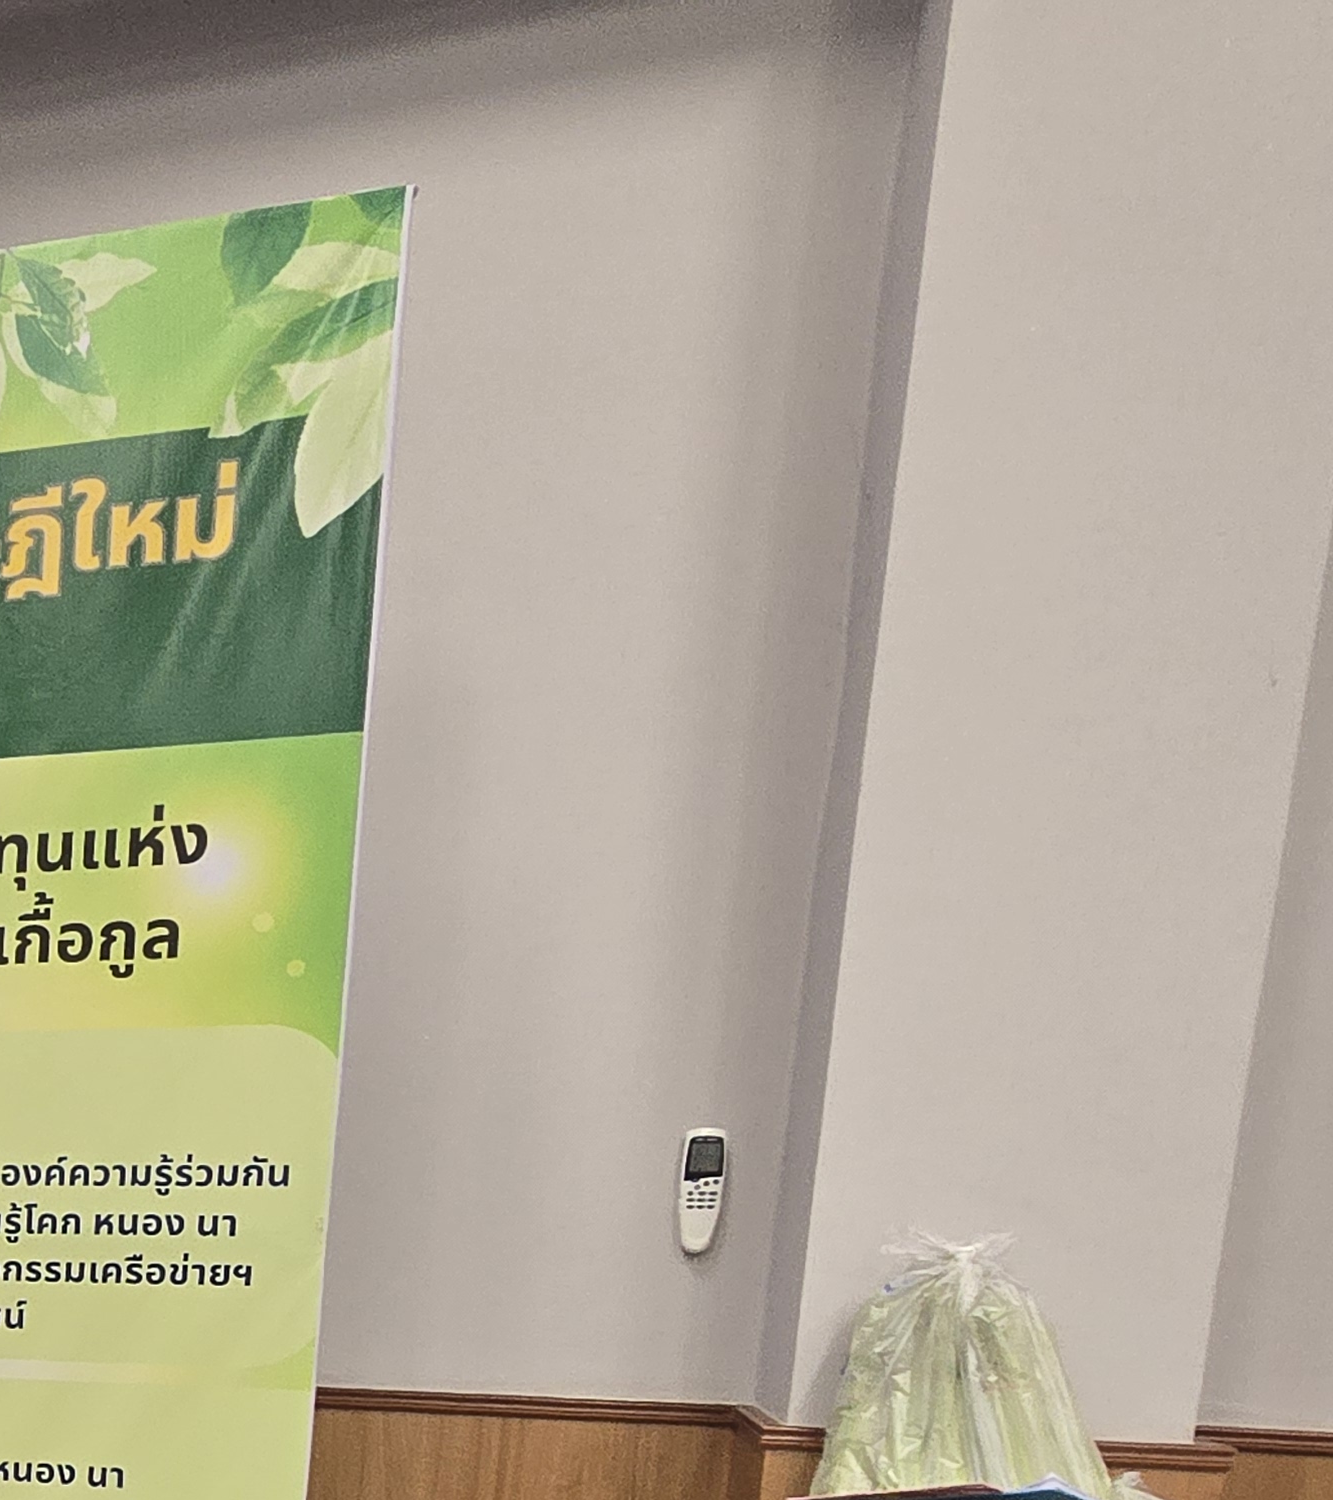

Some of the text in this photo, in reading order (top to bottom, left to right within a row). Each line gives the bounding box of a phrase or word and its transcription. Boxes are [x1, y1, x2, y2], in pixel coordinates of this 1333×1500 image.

[93, 1212, 184, 1238] หนอง
[197, 1213, 236, 1238] นา
[87, 1462, 125, 1489] นา
